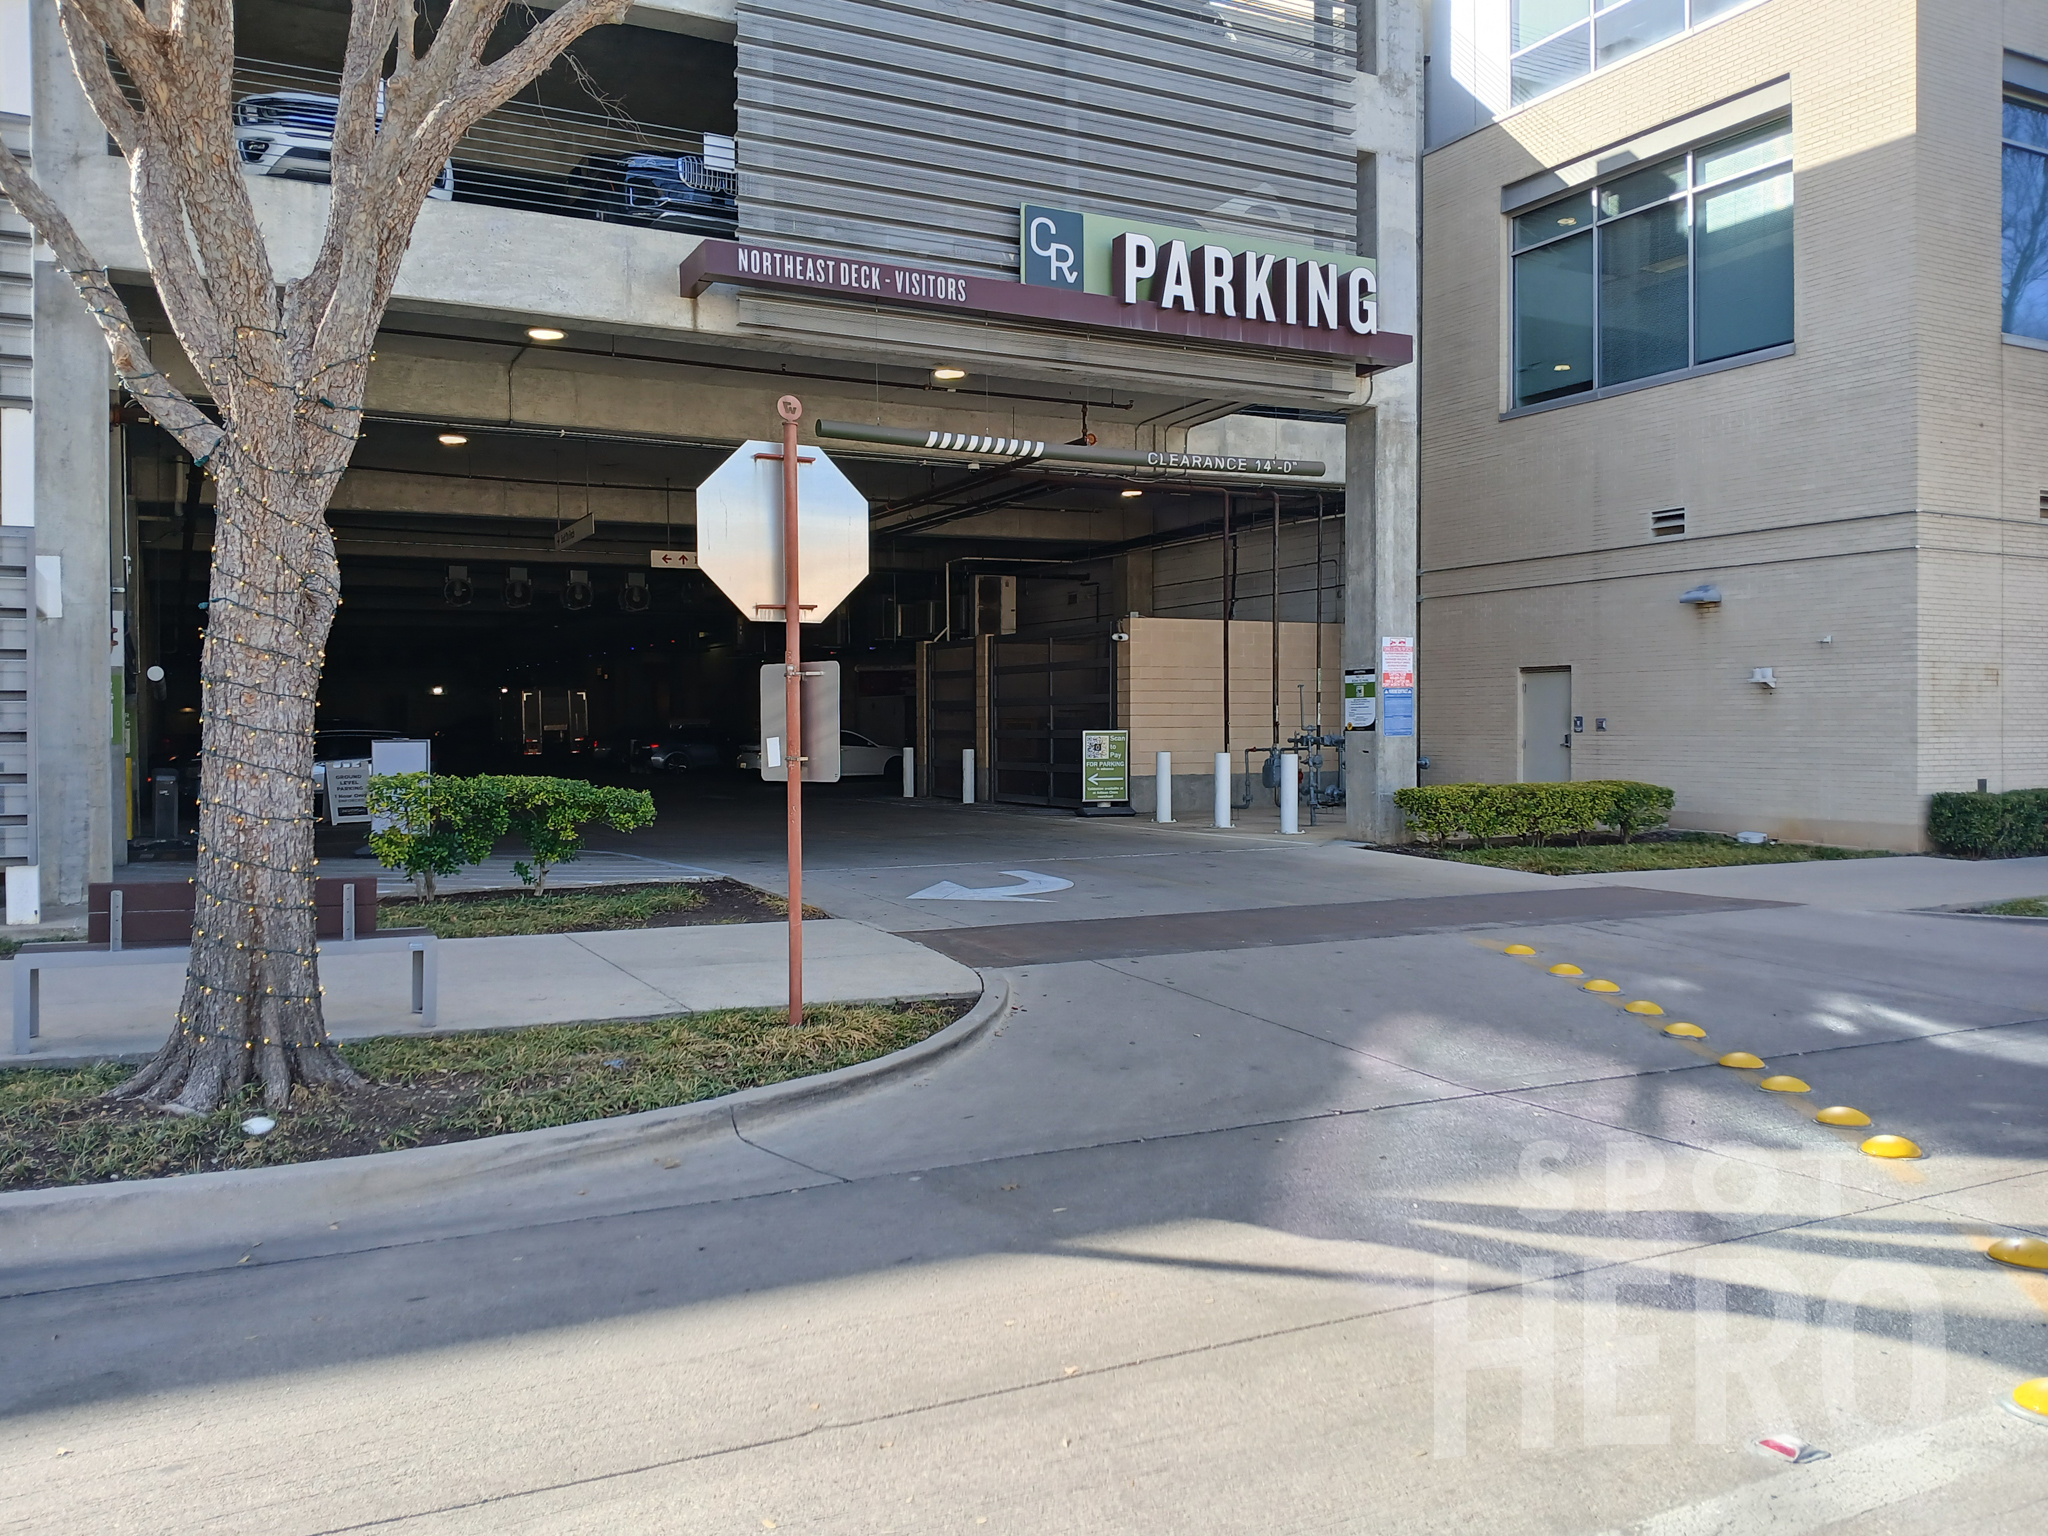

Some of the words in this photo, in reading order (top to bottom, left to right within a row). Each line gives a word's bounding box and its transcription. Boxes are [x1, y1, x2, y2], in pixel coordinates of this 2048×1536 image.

[737, 247, 836, 284] NORTHEAST
[840, 262, 881, 291] DECK
[895, 270, 967, 303] VISITORS
[1124, 232, 1378, 336] PARKING
[1147, 452, 1248, 471] CLEARANCE
